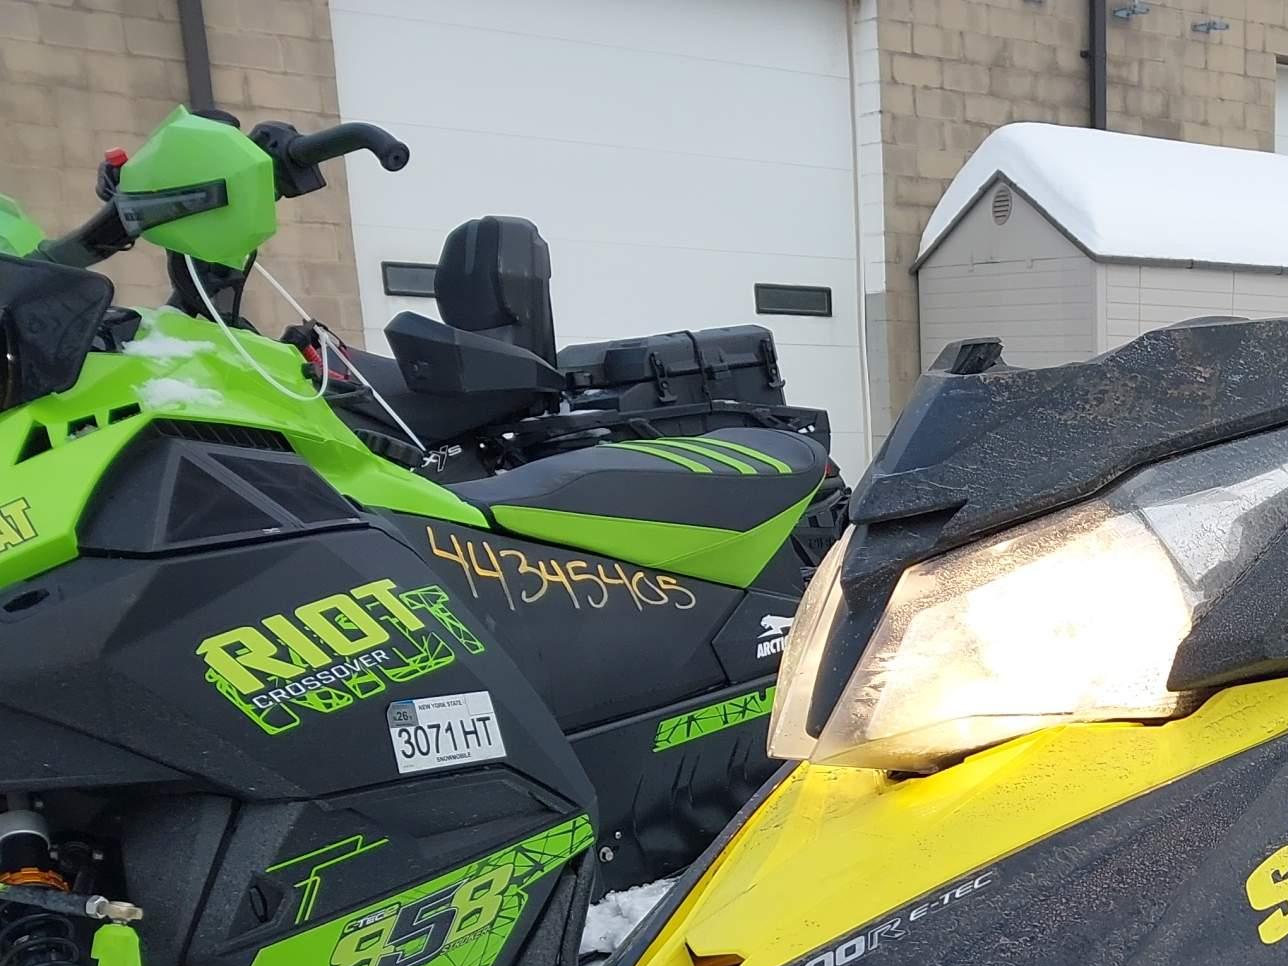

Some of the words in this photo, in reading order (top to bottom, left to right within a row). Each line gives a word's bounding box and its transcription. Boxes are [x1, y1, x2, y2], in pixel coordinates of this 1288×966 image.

[426, 525, 697, 611] 44345405
[195, 577, 425, 695] RIOT
[252, 648, 391, 710] CROSSOVER
[398, 716, 492, 759] 3071HT
[436, 752, 472, 763] SNOWMOBILE
[909, 871, 993, 922] E-TEC
